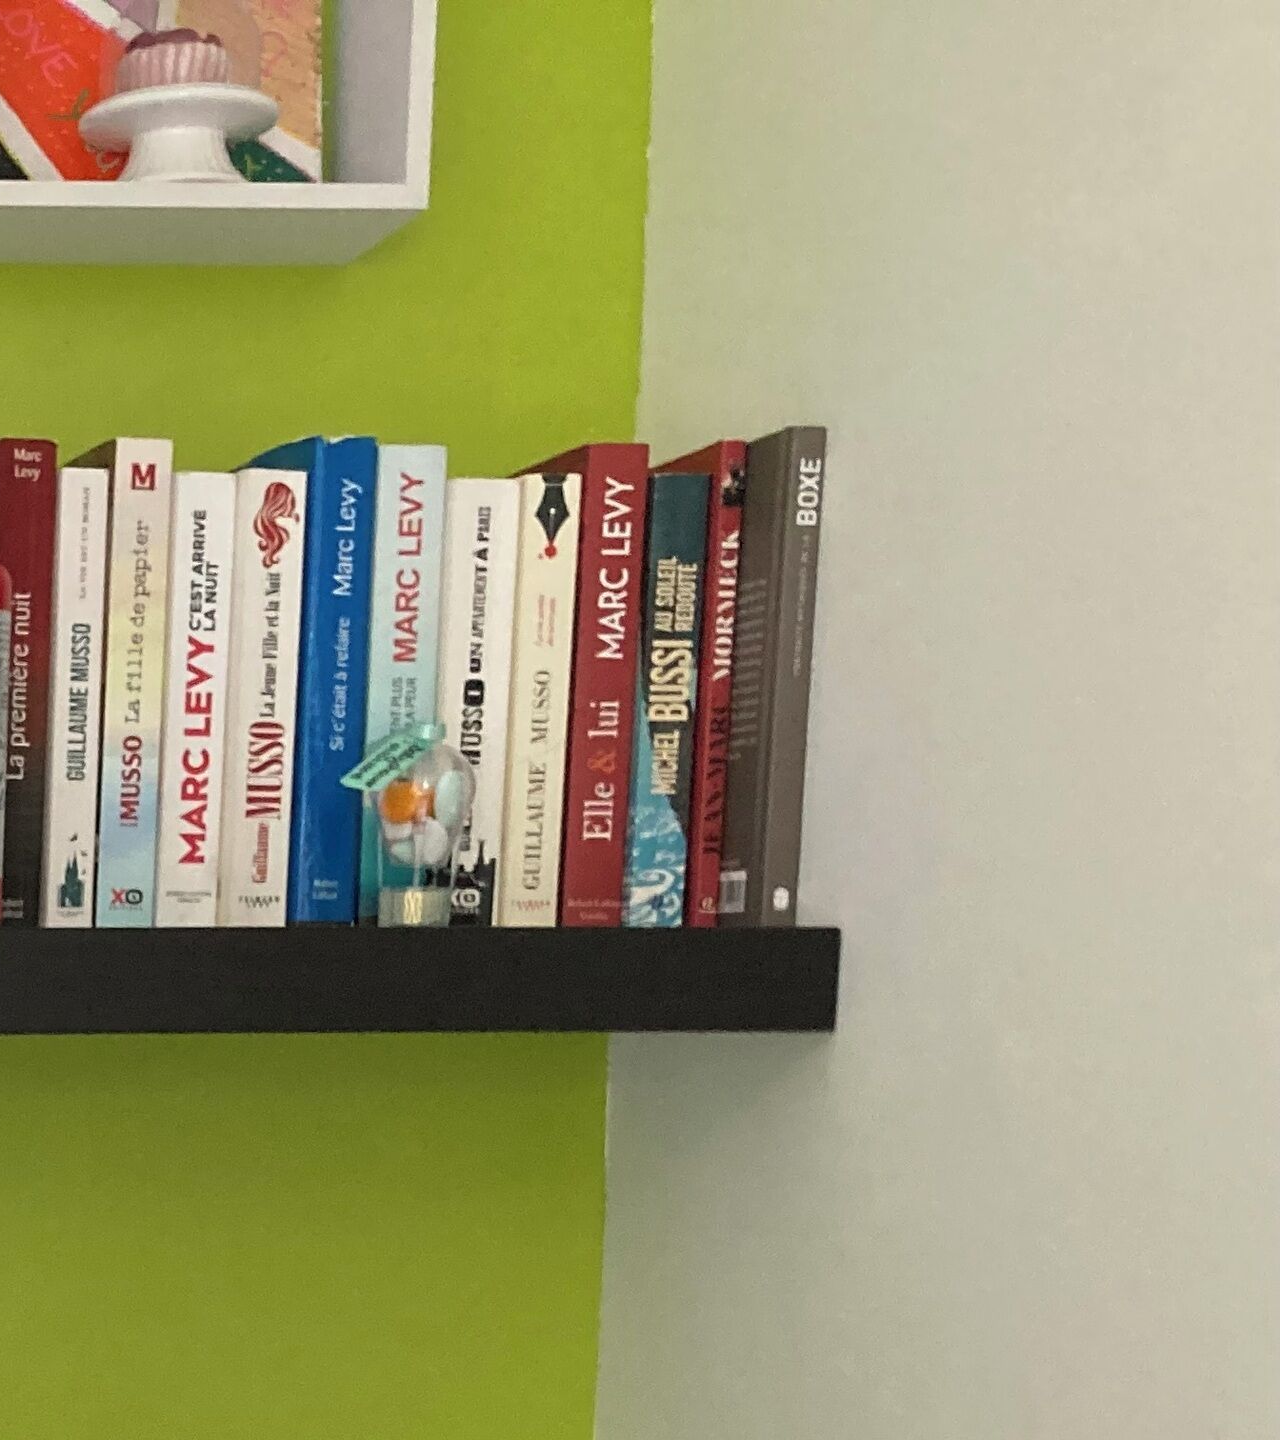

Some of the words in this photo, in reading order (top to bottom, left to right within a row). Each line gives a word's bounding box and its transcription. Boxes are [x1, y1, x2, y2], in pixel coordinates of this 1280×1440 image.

[334, 479, 360, 532] Levy
[396, 472, 424, 557] LEVY
[602, 477, 634, 556] LEVY
[796, 456, 822, 526] BOXE
[129, 519, 152, 597] papier
[204, 560, 220, 604] NUIT
[332, 539, 356, 595] Marc
[658, 556, 679, 607] SOLEIL
[13, 591, 32, 635] nuit
[188, 581, 204, 632] C'EST
[204, 609, 218, 632] LA
[393, 569, 421, 663] MARC
[596, 568, 628, 659] MARC
[713, 530, 740, 682] MORMECK
[67, 622, 91, 682] MUSSO
[184, 633, 215, 738] LEVY
[648, 640, 693, 722] BUSSI
[8, 640, 31, 747] première
[530, 669, 551, 745] MUSSO
[587, 700, 620, 738] lui
[5, 755, 24, 781] La
[65, 687, 90, 781] GUILLAUME
[245, 721, 285, 821] MUSSO
[650, 730, 681, 794] MICHEL
[119, 735, 143, 821] MUSSO
[179, 748, 211, 865] MARC
[582, 781, 614, 841] Elle
[521, 762, 547, 890] GUILLAUME
